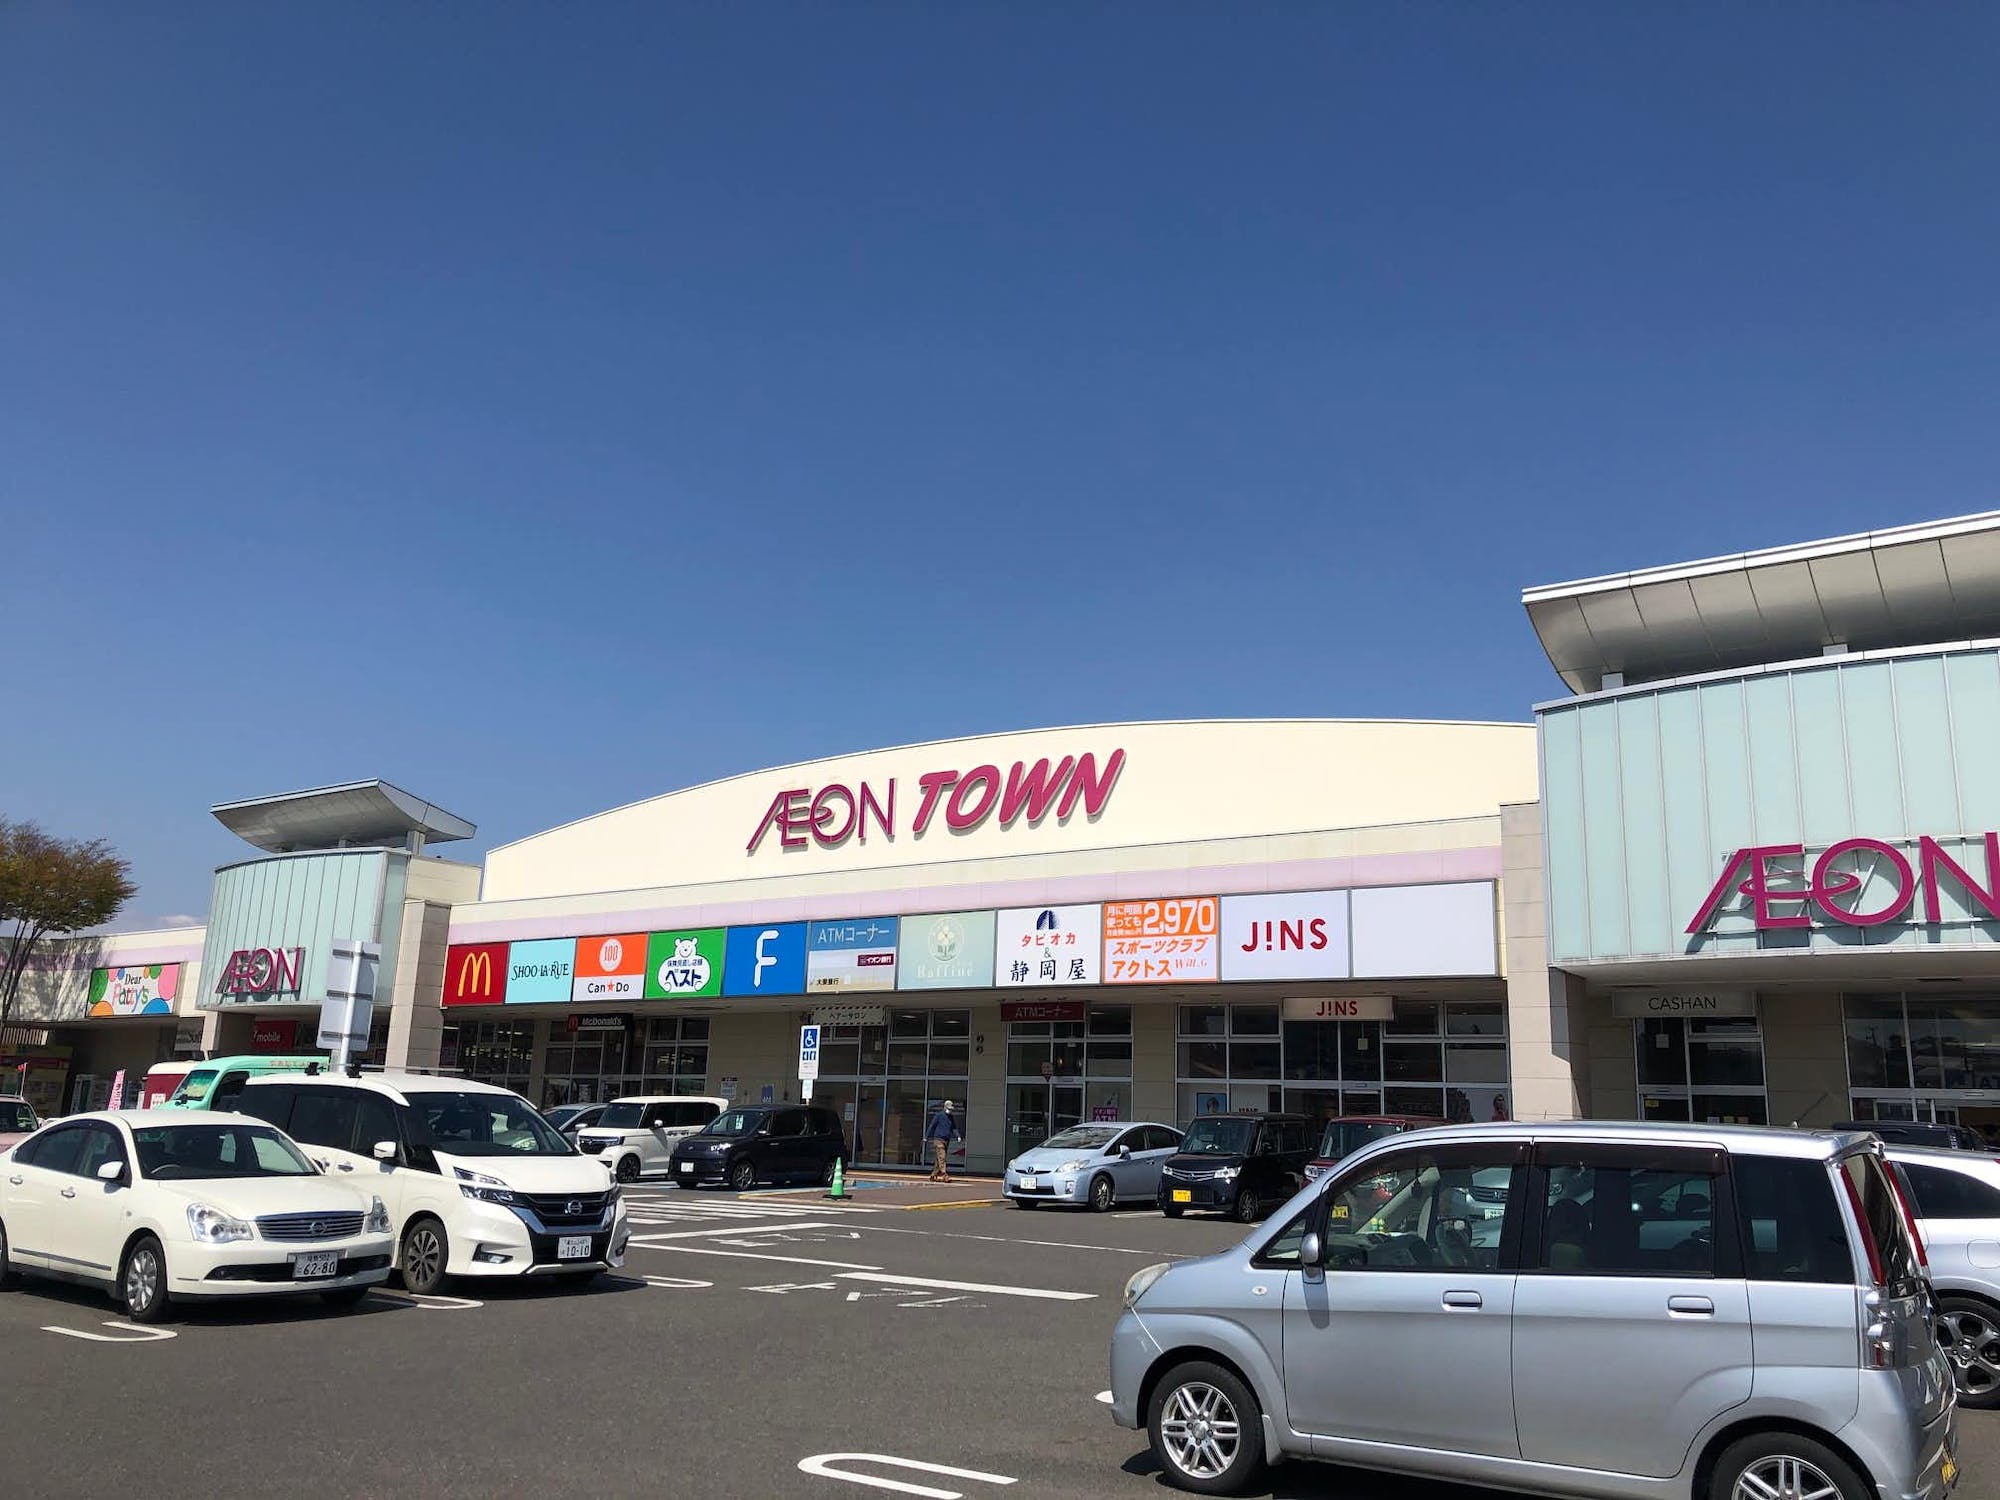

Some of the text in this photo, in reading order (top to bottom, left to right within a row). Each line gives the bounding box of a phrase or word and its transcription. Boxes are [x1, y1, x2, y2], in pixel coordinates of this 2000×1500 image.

[912, 748, 1125, 837] TOWN
[1143, 899, 1215, 936] 2,970
[817, 923, 890, 945] ATMコーナー
[1021, 932, 1077, 948] タピオカ
[603, 944, 619, 962] 100
[1043, 946, 1052, 958] &
[1112, 936, 1209, 957] スポーツクラブ
[1010, 958, 1087, 983] 静岡屋
[1111, 958, 1172, 979] アクトス
[124, 972, 142, 985] Dear
[665, 968, 702, 988] ベスト
[587, 981, 630, 994] Can Do
[1648, 995, 1717, 1011] CASHAN
[581, 1016, 622, 1026] McDonald's
[1015, 1006, 1072, 1019] ATMコーナー
